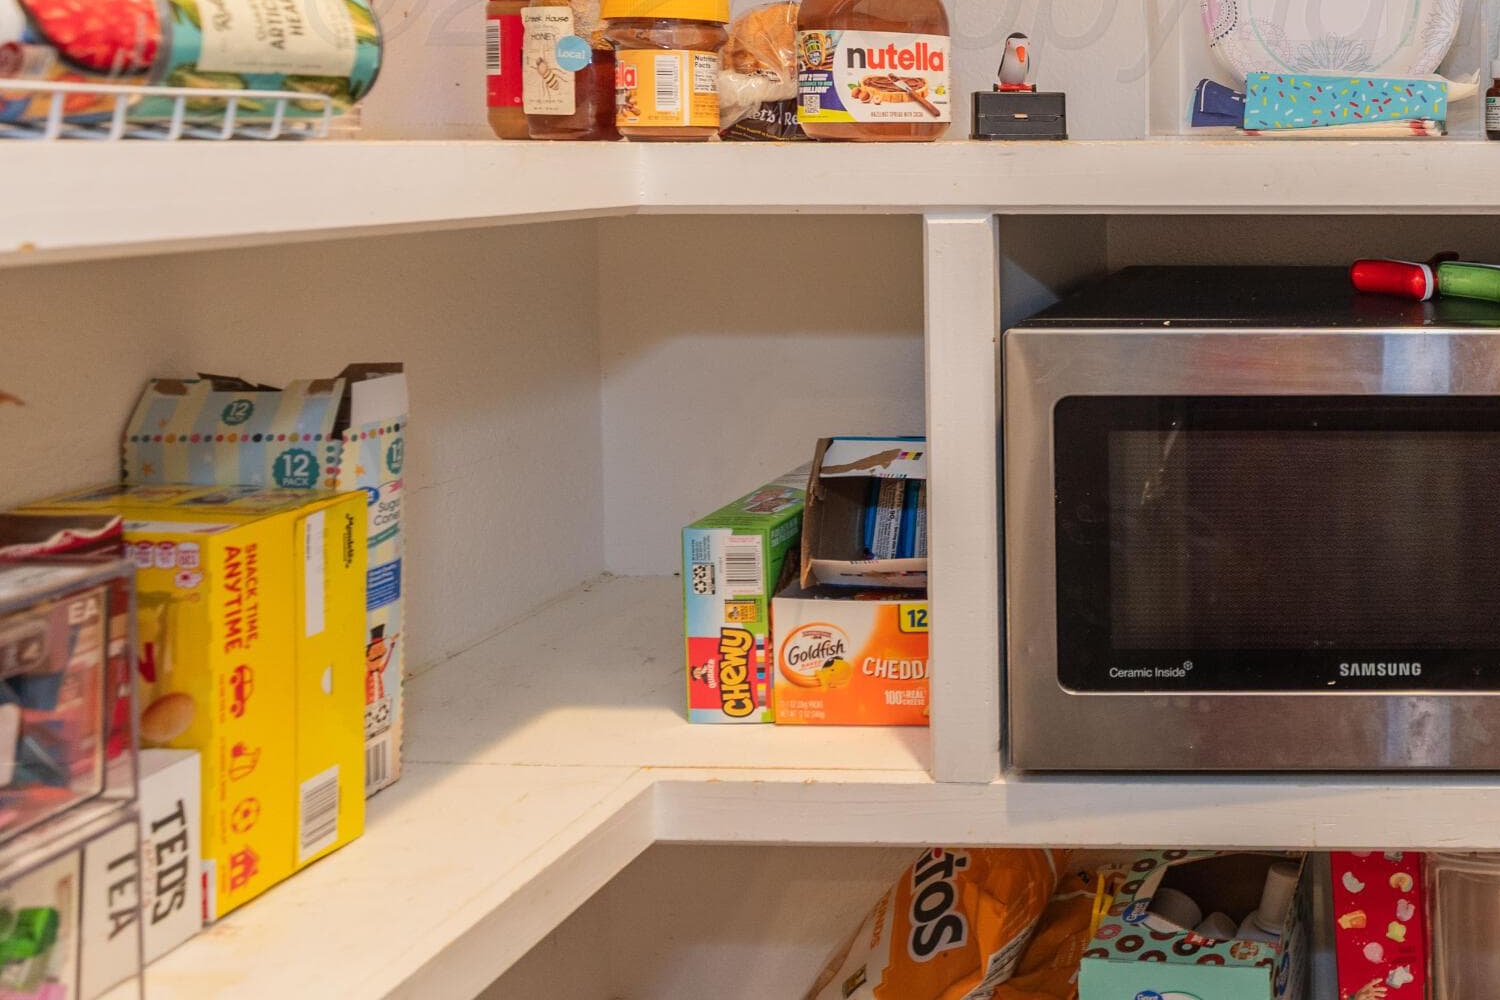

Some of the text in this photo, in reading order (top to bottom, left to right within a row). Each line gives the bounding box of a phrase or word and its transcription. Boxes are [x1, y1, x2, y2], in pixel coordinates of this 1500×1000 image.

[545, 15, 569, 23] House
[530, 33, 557, 41] HONEY
[558, 49, 586, 60] Local
[847, 42, 944, 72] nutella
[282, 454, 310, 477] 12
[282, 478, 309, 487] PACK
[245, 543, 258, 597] SNACK
[223, 546, 243, 654] ANYTIME
[906, 609, 928, 628] 12
[788, 639, 846, 666] Goldfish
[862, 656, 930, 680] CHEDD
[1109, 666, 1186, 678] Ceramic Inside
[1339, 662, 1422, 676] SAMSUNG
[106, 850, 138, 941] TEA
